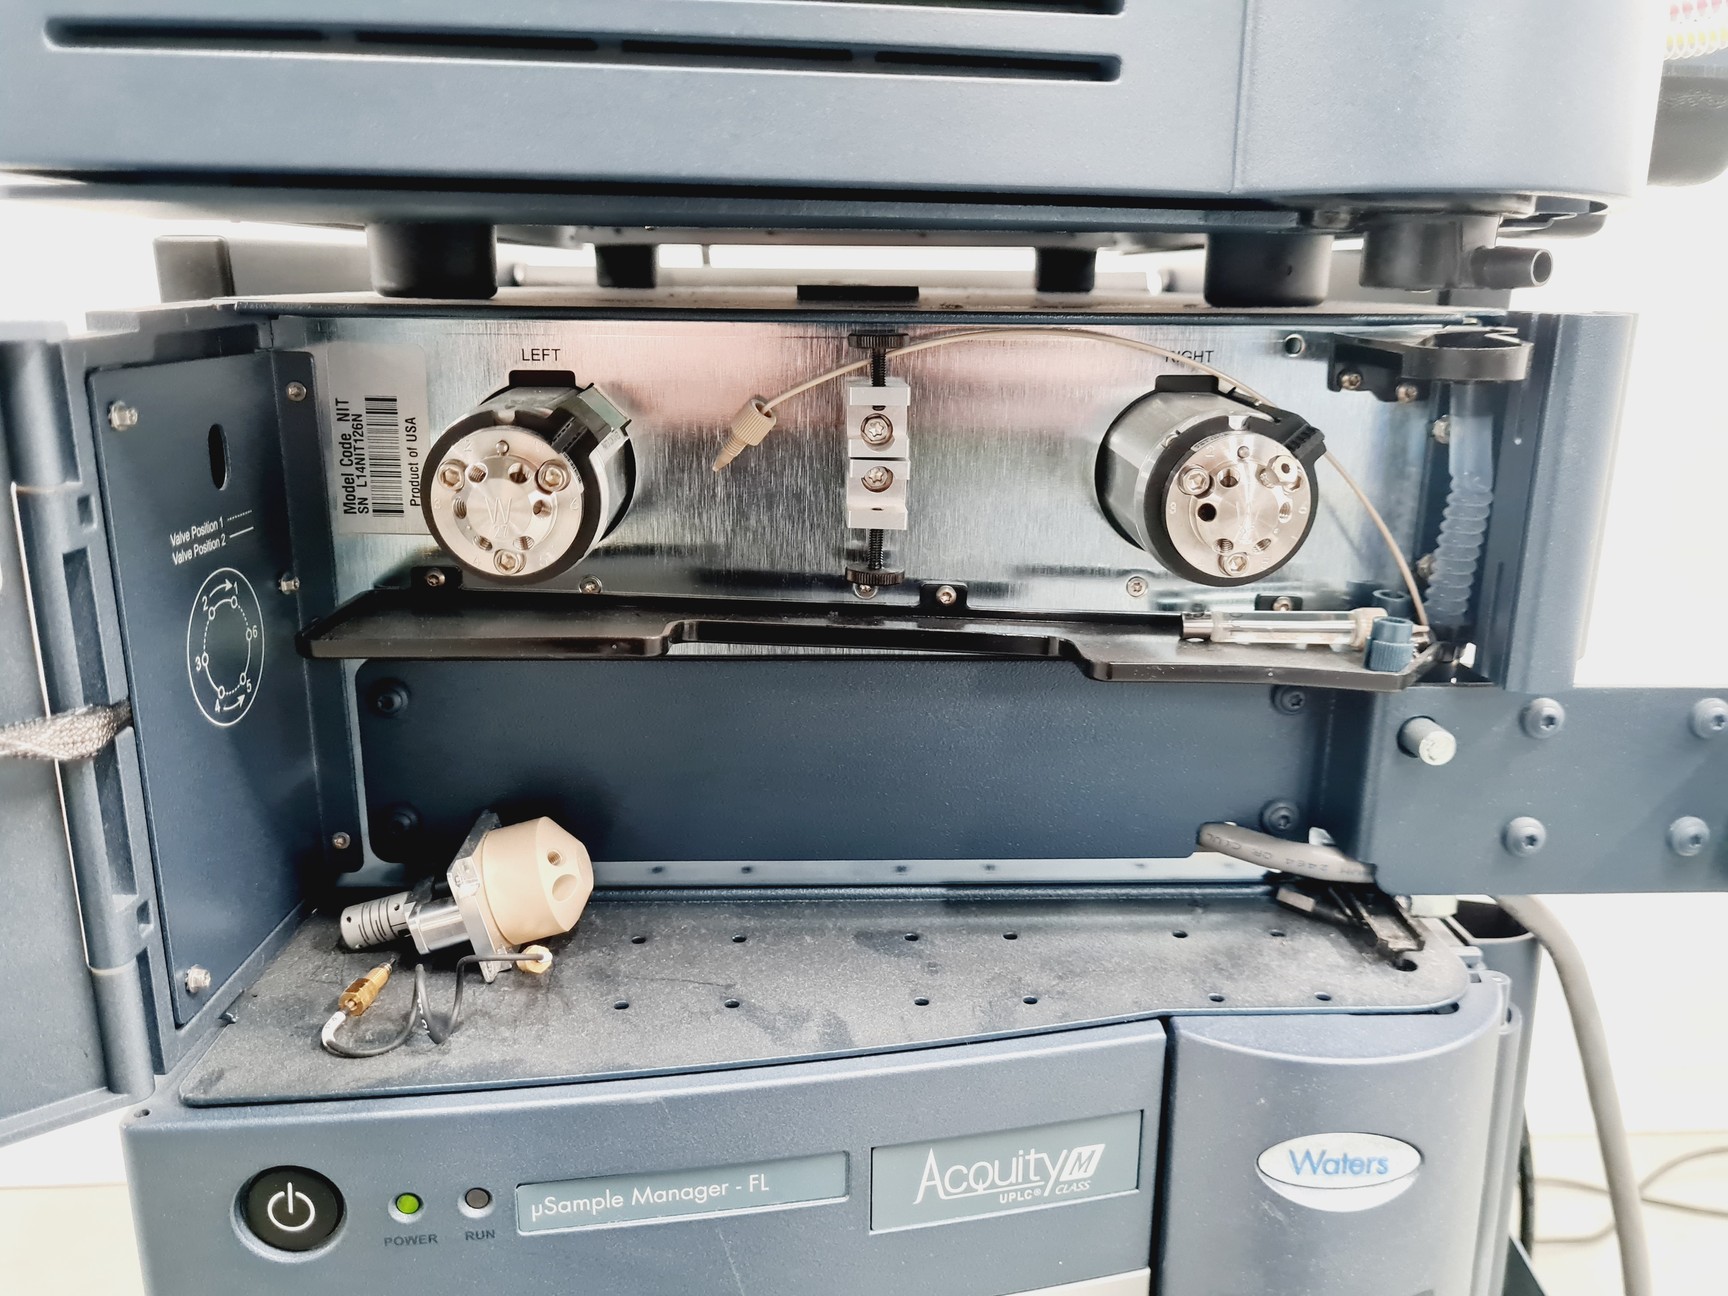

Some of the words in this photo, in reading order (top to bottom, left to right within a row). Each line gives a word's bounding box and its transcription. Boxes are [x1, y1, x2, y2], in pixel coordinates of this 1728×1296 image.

[521, 348, 561, 361] LEFT
[335, 398, 351, 422] NIT
[405, 417, 418, 442] USA
[338, 433, 354, 467] Code
[352, 413, 368, 488] L14NIT126N
[406, 446, 419, 458] of
[408, 461, 421, 507] Product
[341, 473, 358, 515] Model
[357, 497, 370, 514] SN
[485, 497, 513, 524] W
[170, 531, 190, 546] Valve
[191, 520, 218, 539] Position
[219, 516, 224, 528] 1
[172, 549, 193, 565] Valve
[193, 538, 220, 557] Position
[221, 533, 226, 546] 2
[233, 581, 238, 595] 1
[202, 595, 208, 611] 2
[252, 625, 258, 638] 6
[195, 656, 202, 671] 3
[246, 679, 252, 692] 5
[215, 698, 221, 713] 4
[1289, 1148, 1389, 1176] Waters
[631, 1182, 729, 1206] Manager
[749, 1173, 769, 1192] FL
[1055, 1180, 1092, 1196] CLASS
[384, 1233, 438, 1247] POWER
[465, 1229, 496, 1241] RUN
